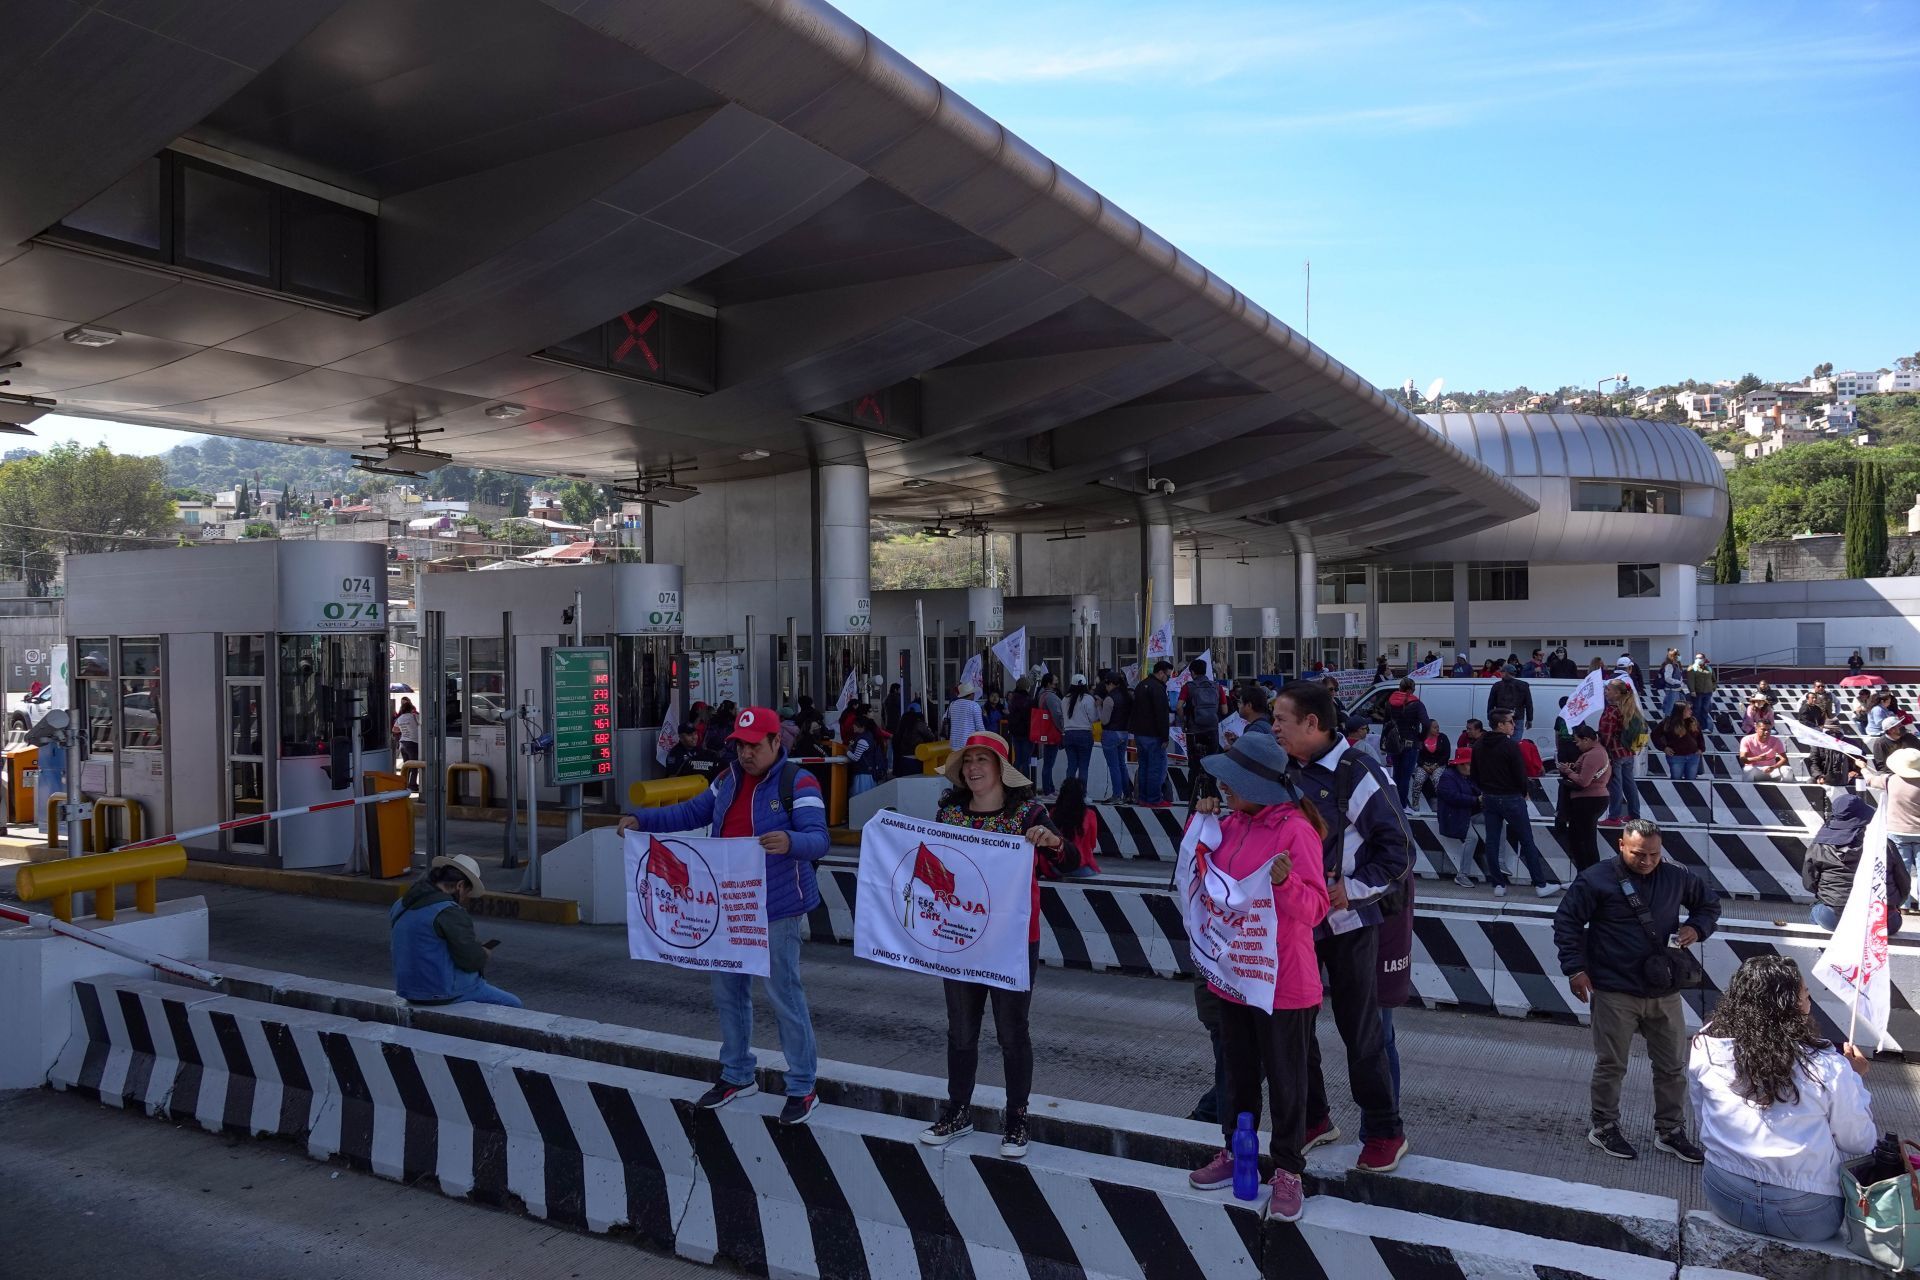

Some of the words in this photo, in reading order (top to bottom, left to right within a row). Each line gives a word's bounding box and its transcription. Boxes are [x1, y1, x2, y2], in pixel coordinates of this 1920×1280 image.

[342, 578, 371, 592] 074
[658, 592, 676, 604] 074
[857, 599, 870, 609] 074
[323, 602, 379, 620] 074
[648, 611, 682, 625] 074
[596, 674, 609, 684] 149
[593, 689, 609, 700] 273
[593, 704, 610, 715] 275
[594, 718, 610, 730] 467
[594, 733, 610, 745] 682
[598, 762, 612, 774] 137
[880, 816, 916, 833] ASAMBLEA
[916, 825, 926, 835] DE
[926, 827, 980, 844] COORDINACIÓN
[981, 836, 1011, 849] SECCIÓN
[1011, 842, 1020, 850] 10
[673, 885, 718, 906] ROJA
[934, 889, 987, 916] ROJA
[938, 924, 973, 940] Coordinación
[942, 918, 969, 932] Asamblea
[932, 928, 954, 940] Sección
[954, 936, 965, 946] 10
[872, 948, 901, 962] UNIDOS
[902, 954, 908, 963] Y
[908, 956, 962, 976] ORGANIZADOS
